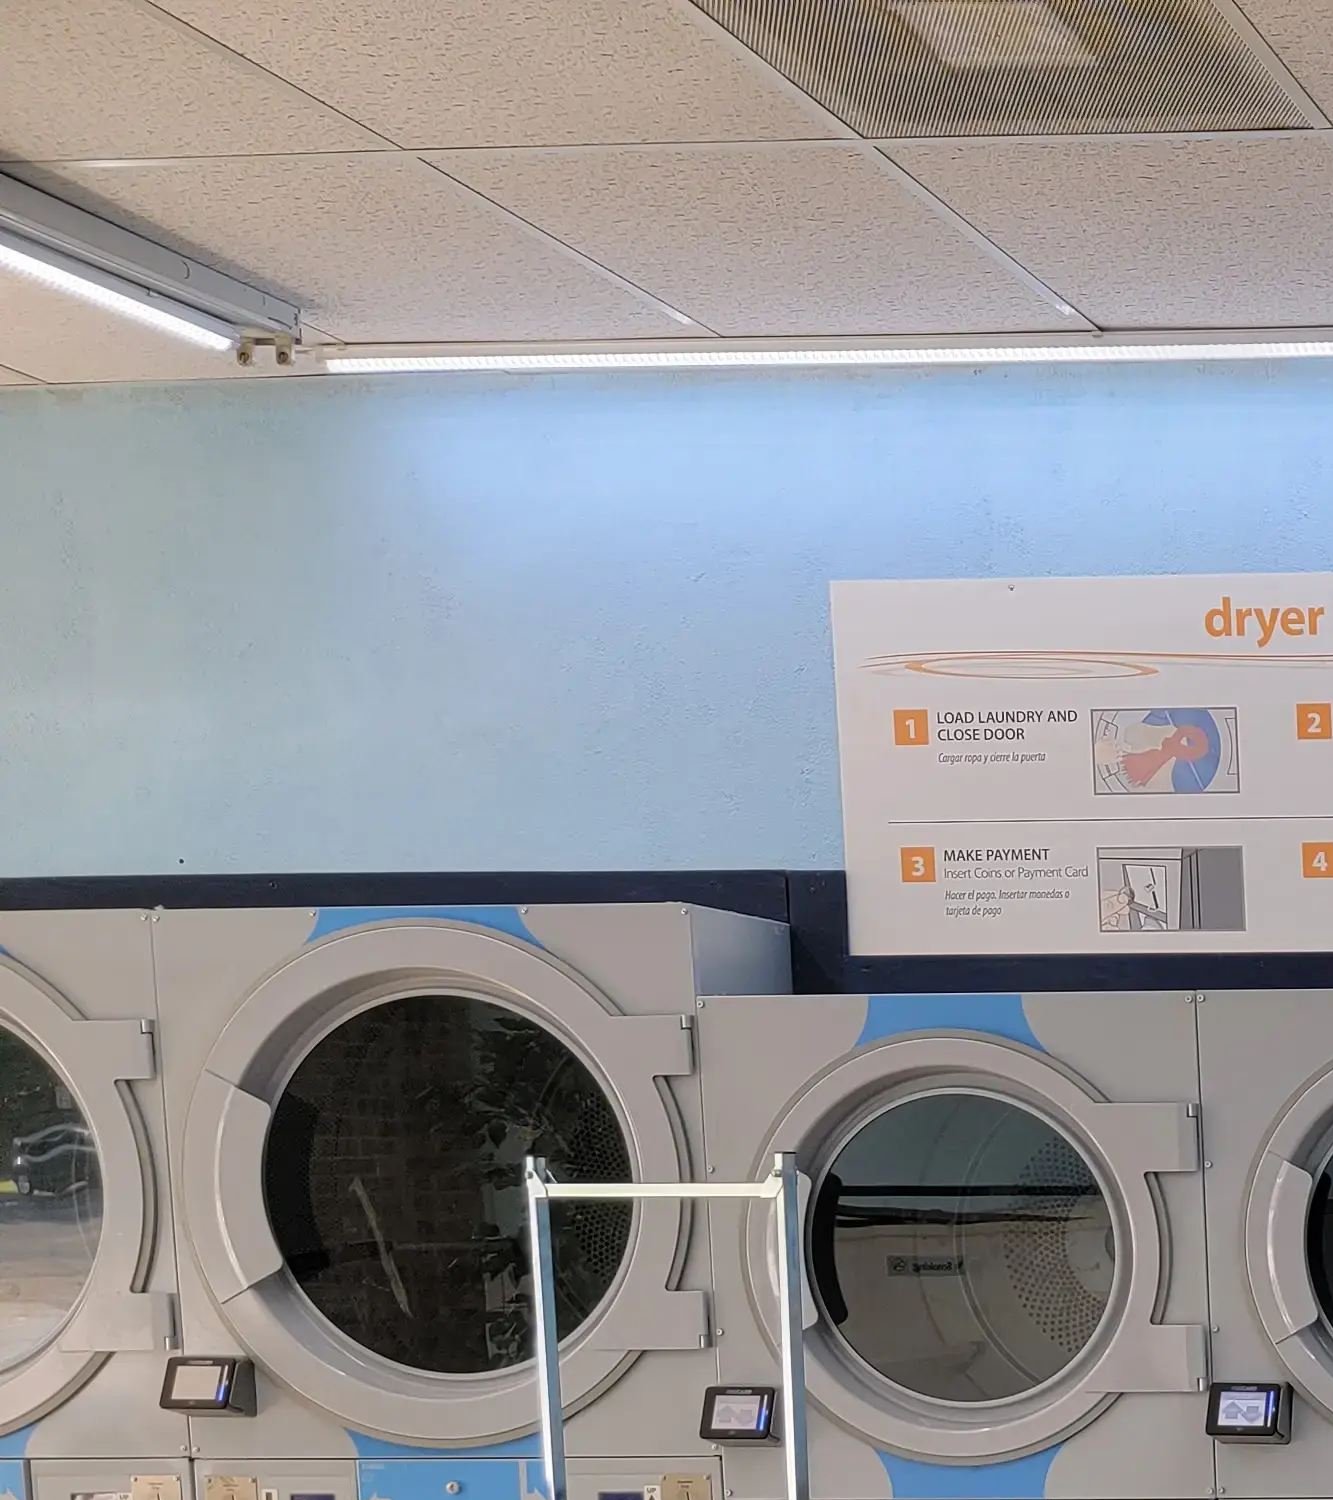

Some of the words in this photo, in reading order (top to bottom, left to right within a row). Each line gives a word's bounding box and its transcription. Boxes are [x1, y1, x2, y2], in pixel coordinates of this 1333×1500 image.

[1204, 596, 1325, 648] dryer
[936, 711, 974, 724] LOAD
[978, 710, 1043, 724] LAUNDRY
[1046, 710, 1078, 723] AND
[1307, 712, 1321, 733] 2
[905, 718, 916, 739] 1
[937, 728, 980, 741] CLOSE
[984, 728, 1025, 740] DOOR
[938, 752, 963, 765] Cargar
[964, 754, 982, 764] ropa
[990, 752, 1010, 762] cierre
[1012, 751, 1019, 762] la
[1020, 752, 1046, 763] puerta
[943, 849, 982, 862] MAKE
[986, 848, 1050, 861] PAYMENT
[1312, 851, 1327, 871] 4
[911, 856, 925, 876] 3
[944, 867, 972, 879] Insert
[974, 867, 1002, 878] Coins
[1004, 869, 1014, 878] or
[1018, 866, 1062, 881] Payment
[1065, 866, 1089, 878] Card
[945, 890, 966, 901] Hacer
[968, 890, 975, 900] el
[999, 889, 1028, 900] Insertar
[1029, 888, 1063, 899] monedas
[946, 905, 971, 917] tarjeta
[972, 906, 981, 916] de
[982, 906, 1002, 917] pago
